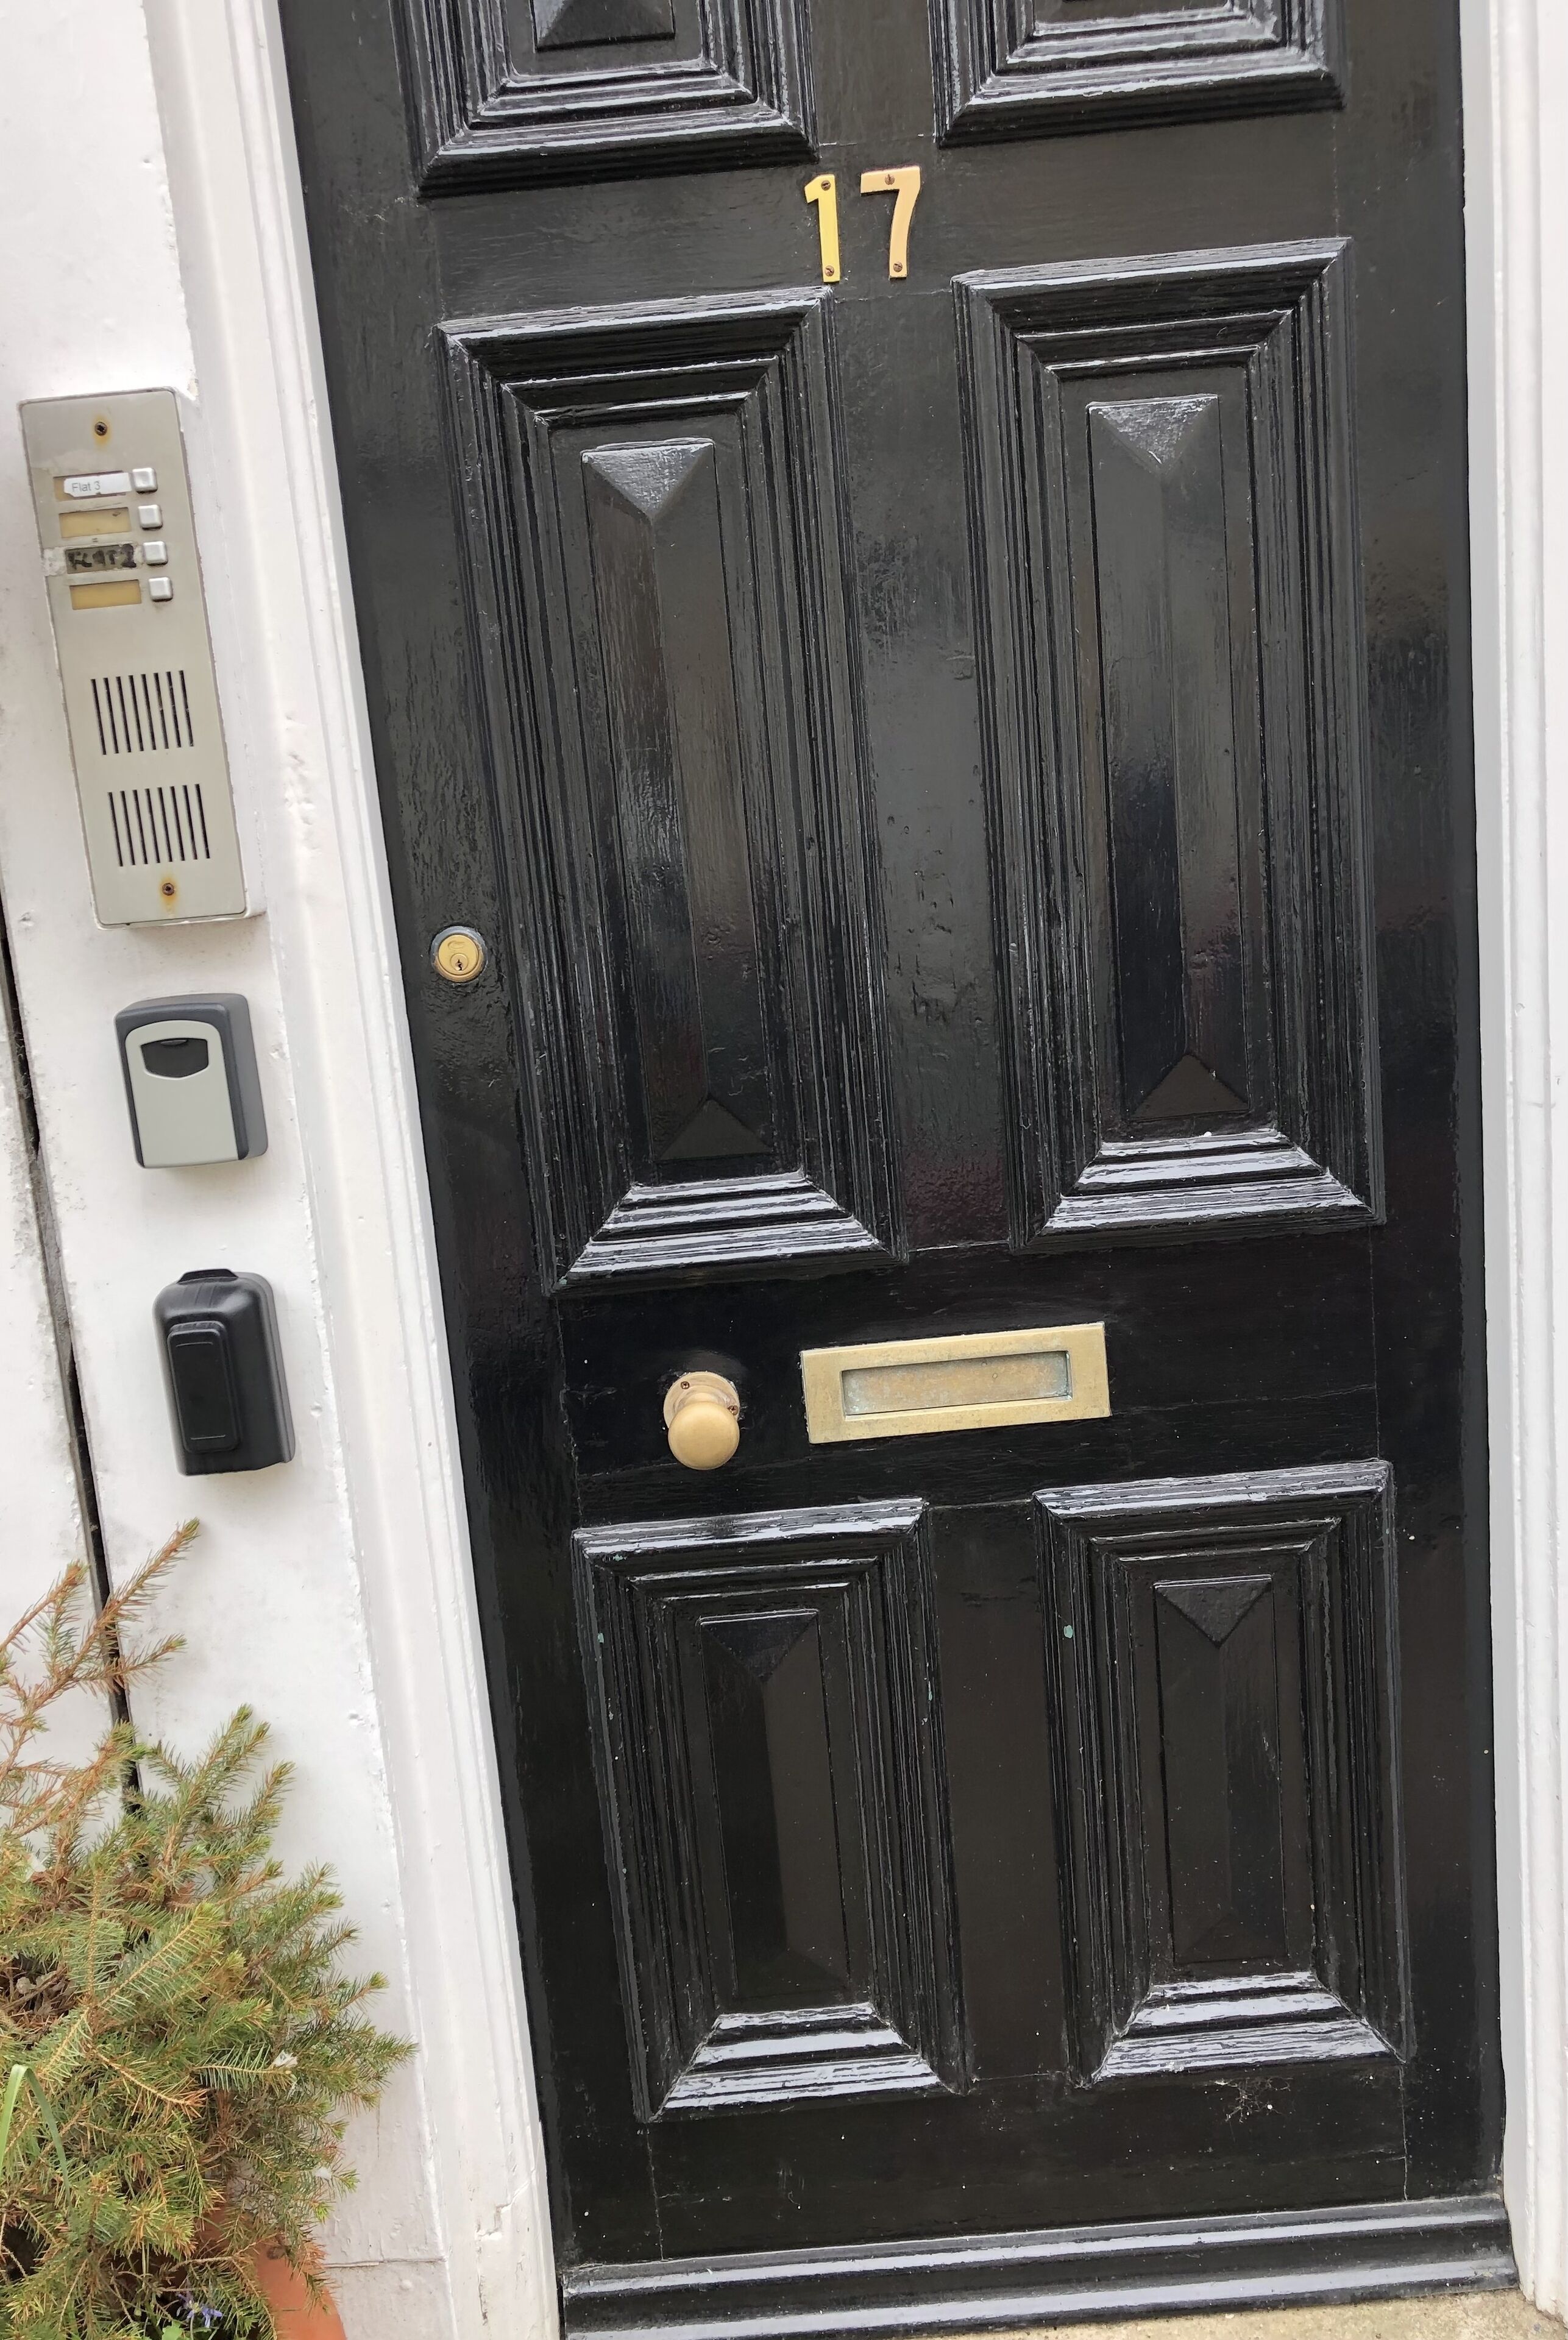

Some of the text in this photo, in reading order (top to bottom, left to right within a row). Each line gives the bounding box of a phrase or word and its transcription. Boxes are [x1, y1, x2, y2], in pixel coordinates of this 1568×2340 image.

[804, 166, 921, 283] 17
[71, 480, 101, 492] Flat 3
